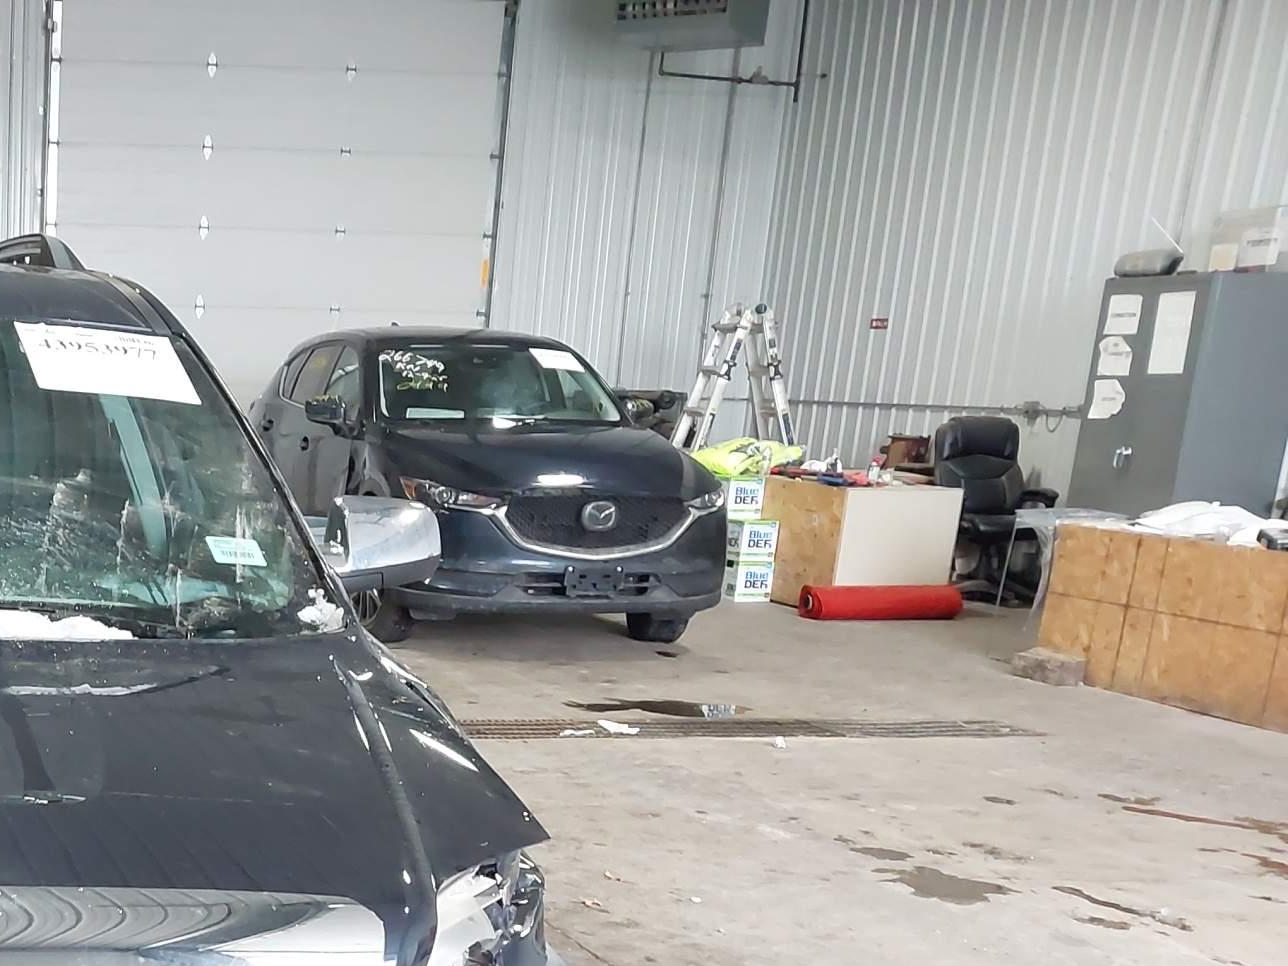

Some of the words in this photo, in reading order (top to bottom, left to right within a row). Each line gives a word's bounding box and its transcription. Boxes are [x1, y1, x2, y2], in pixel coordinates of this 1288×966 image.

[735, 486, 759, 496] Blue
[749, 530, 772, 539] Blue
[745, 571, 769, 580] Blue
